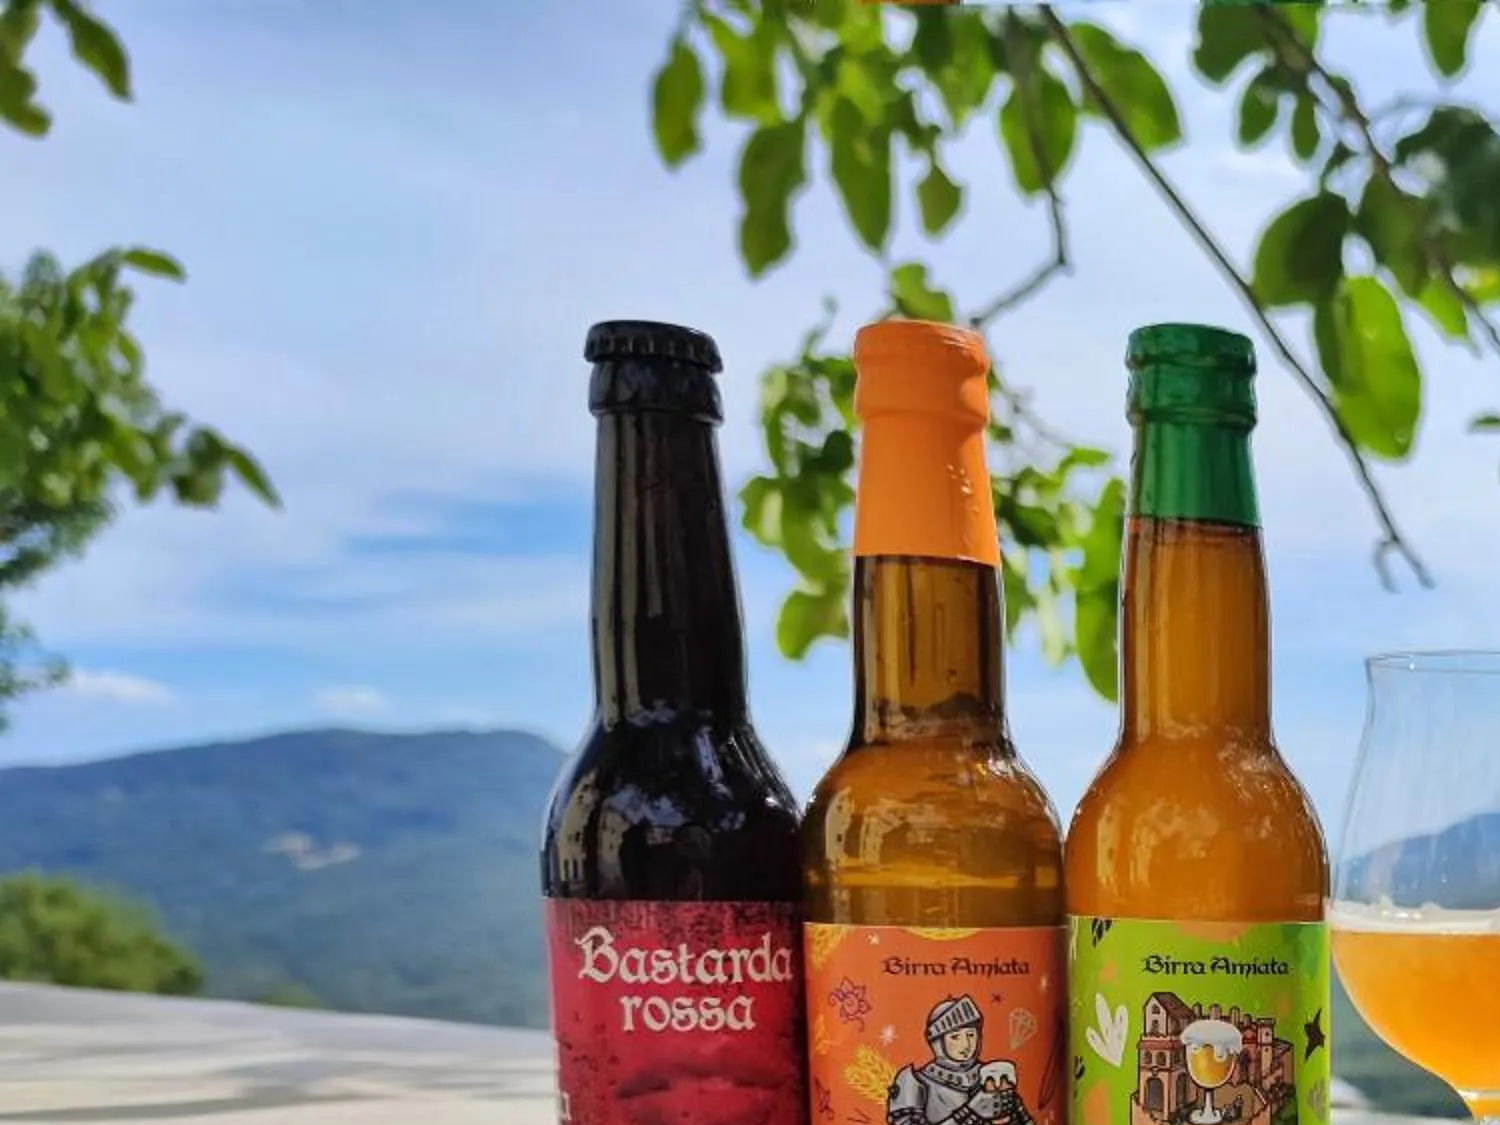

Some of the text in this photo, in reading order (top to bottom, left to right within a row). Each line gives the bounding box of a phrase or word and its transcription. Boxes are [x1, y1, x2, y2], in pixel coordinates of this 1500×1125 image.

[575, 926, 794, 985] Bastarda
[881, 955, 1031, 979] Birra Amiata
[1141, 955, 1291, 979] Birra Amiata
[619, 996, 757, 1032] rossa
